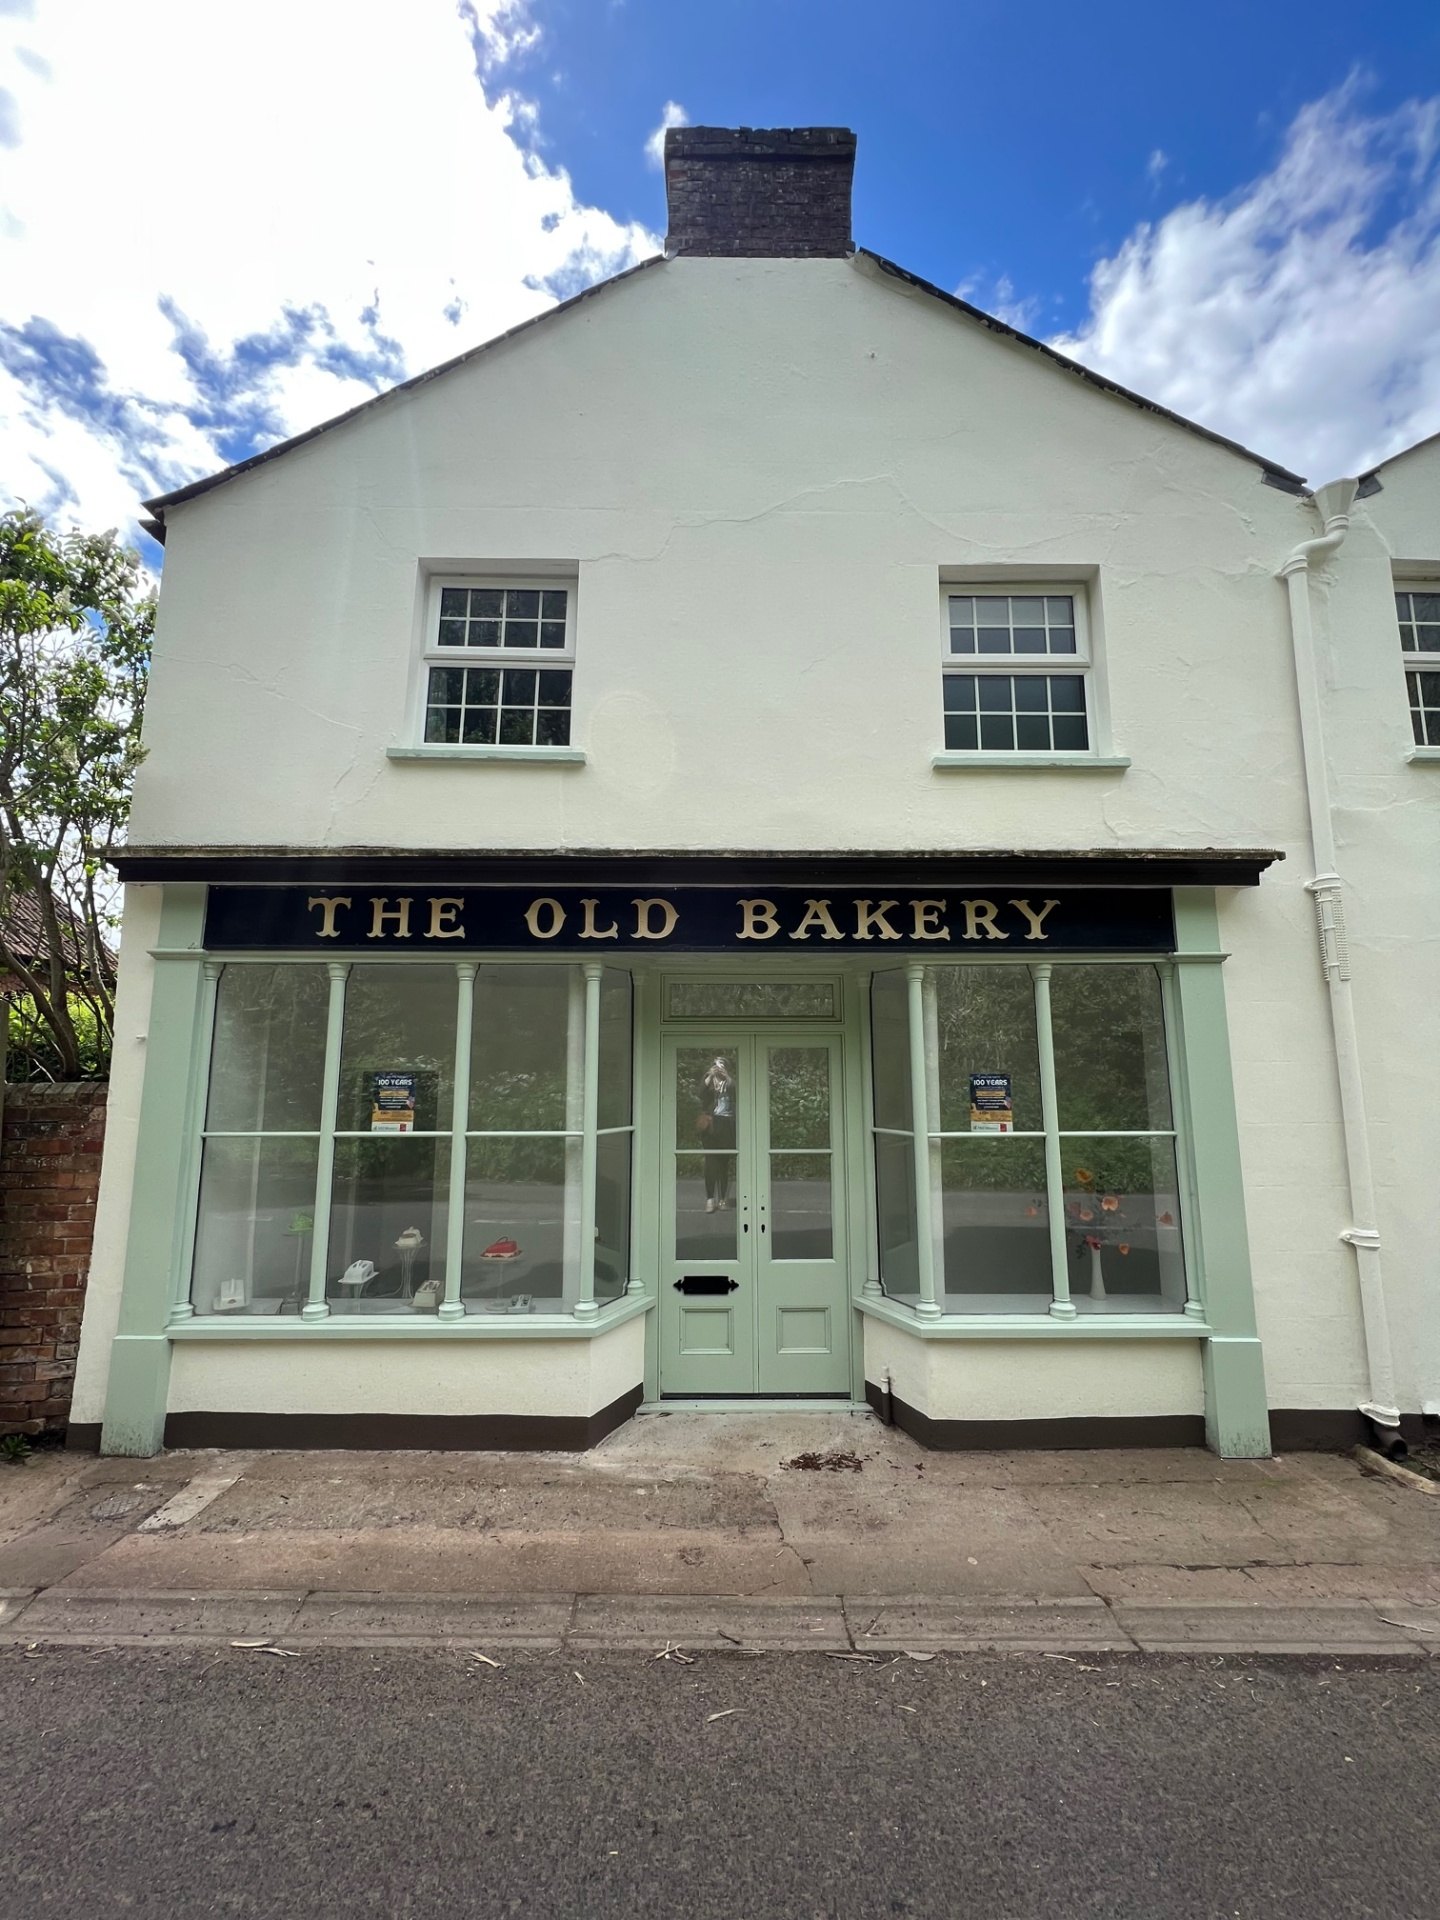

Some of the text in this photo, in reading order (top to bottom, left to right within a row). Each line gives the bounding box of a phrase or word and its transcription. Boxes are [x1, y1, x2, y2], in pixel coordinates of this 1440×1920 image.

[308, 896, 1061, 941] THE OLD BAKERY
